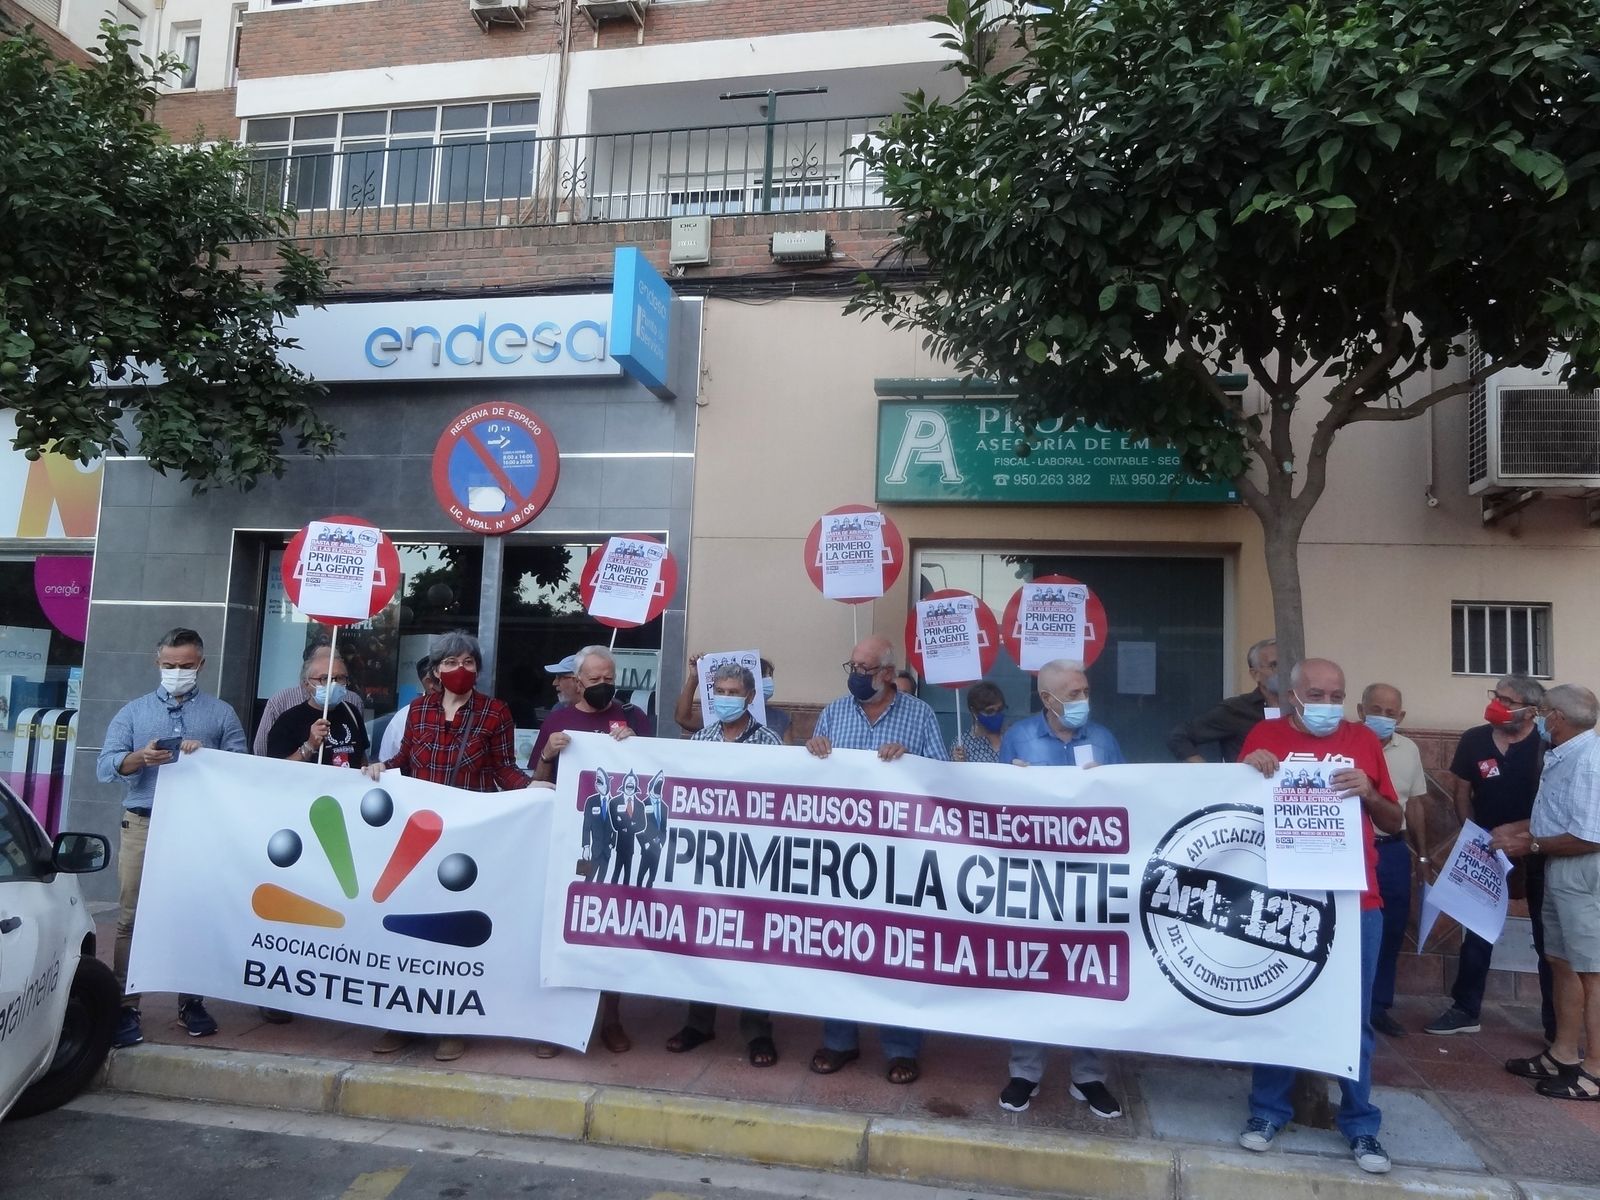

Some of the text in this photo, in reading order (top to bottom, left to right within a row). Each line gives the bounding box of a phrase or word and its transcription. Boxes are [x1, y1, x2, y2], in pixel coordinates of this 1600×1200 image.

[365, 312, 608, 368] endesa
[450, 407, 542, 436] RESERVA DE ESPACIO
[1085, 438, 1111, 450] DE
[994, 457, 1030, 466] FISCAL
[1038, 457, 1085, 466] LABORAL
[1093, 457, 1149, 466] CONTABLE
[1013, 474, 1064, 486] 950.263
[1067, 474, 1091, 485] 382
[449, 505, 463, 521] LIC.
[466, 516, 492, 530] MPAL.
[511, 503, 535, 524] 18/06
[826, 541, 871, 551] PRIMERO
[308, 552, 363, 566] PRIMERO
[826, 550, 874, 560] LA GENTE
[307, 562, 321, 572] LA
[326, 564, 365, 576] GENTE
[605, 563, 649, 577] PRIMERO
[602, 572, 615, 581] LA
[617, 574, 649, 586] GENTE
[1025, 612, 1074, 622] PRIMERO
[923, 624, 966, 637] PRIMERO
[1025, 622, 1076, 632] LA GENTE
[925, 633, 969, 645] LA GENTE
[671, 785, 1123, 847] BASTA DE ABUSOS DE LAS ELÉCTRICAS
[1274, 804, 1341, 816] PRIMERO
[1275, 817, 1345, 830] LA GENTE
[1186, 828, 1266, 862] APLICACIÓ
[664, 826, 1130, 924] PRIMERO LA GENTE
[1459, 851, 1502, 887] PRIMERO
[1454, 859, 1468, 874] LA
[1471, 870, 1502, 897] GENTE
[570, 894, 1117, 986] ¡BAJADA DEL PRECIO DE LA LUZ YA!
[251, 932, 485, 977] ASOCIACIÓN DE VECINOS
[1167, 925, 1289, 992] DE LA CONSTITUCIÓN
[243, 959, 486, 1016] BASTETANIA
